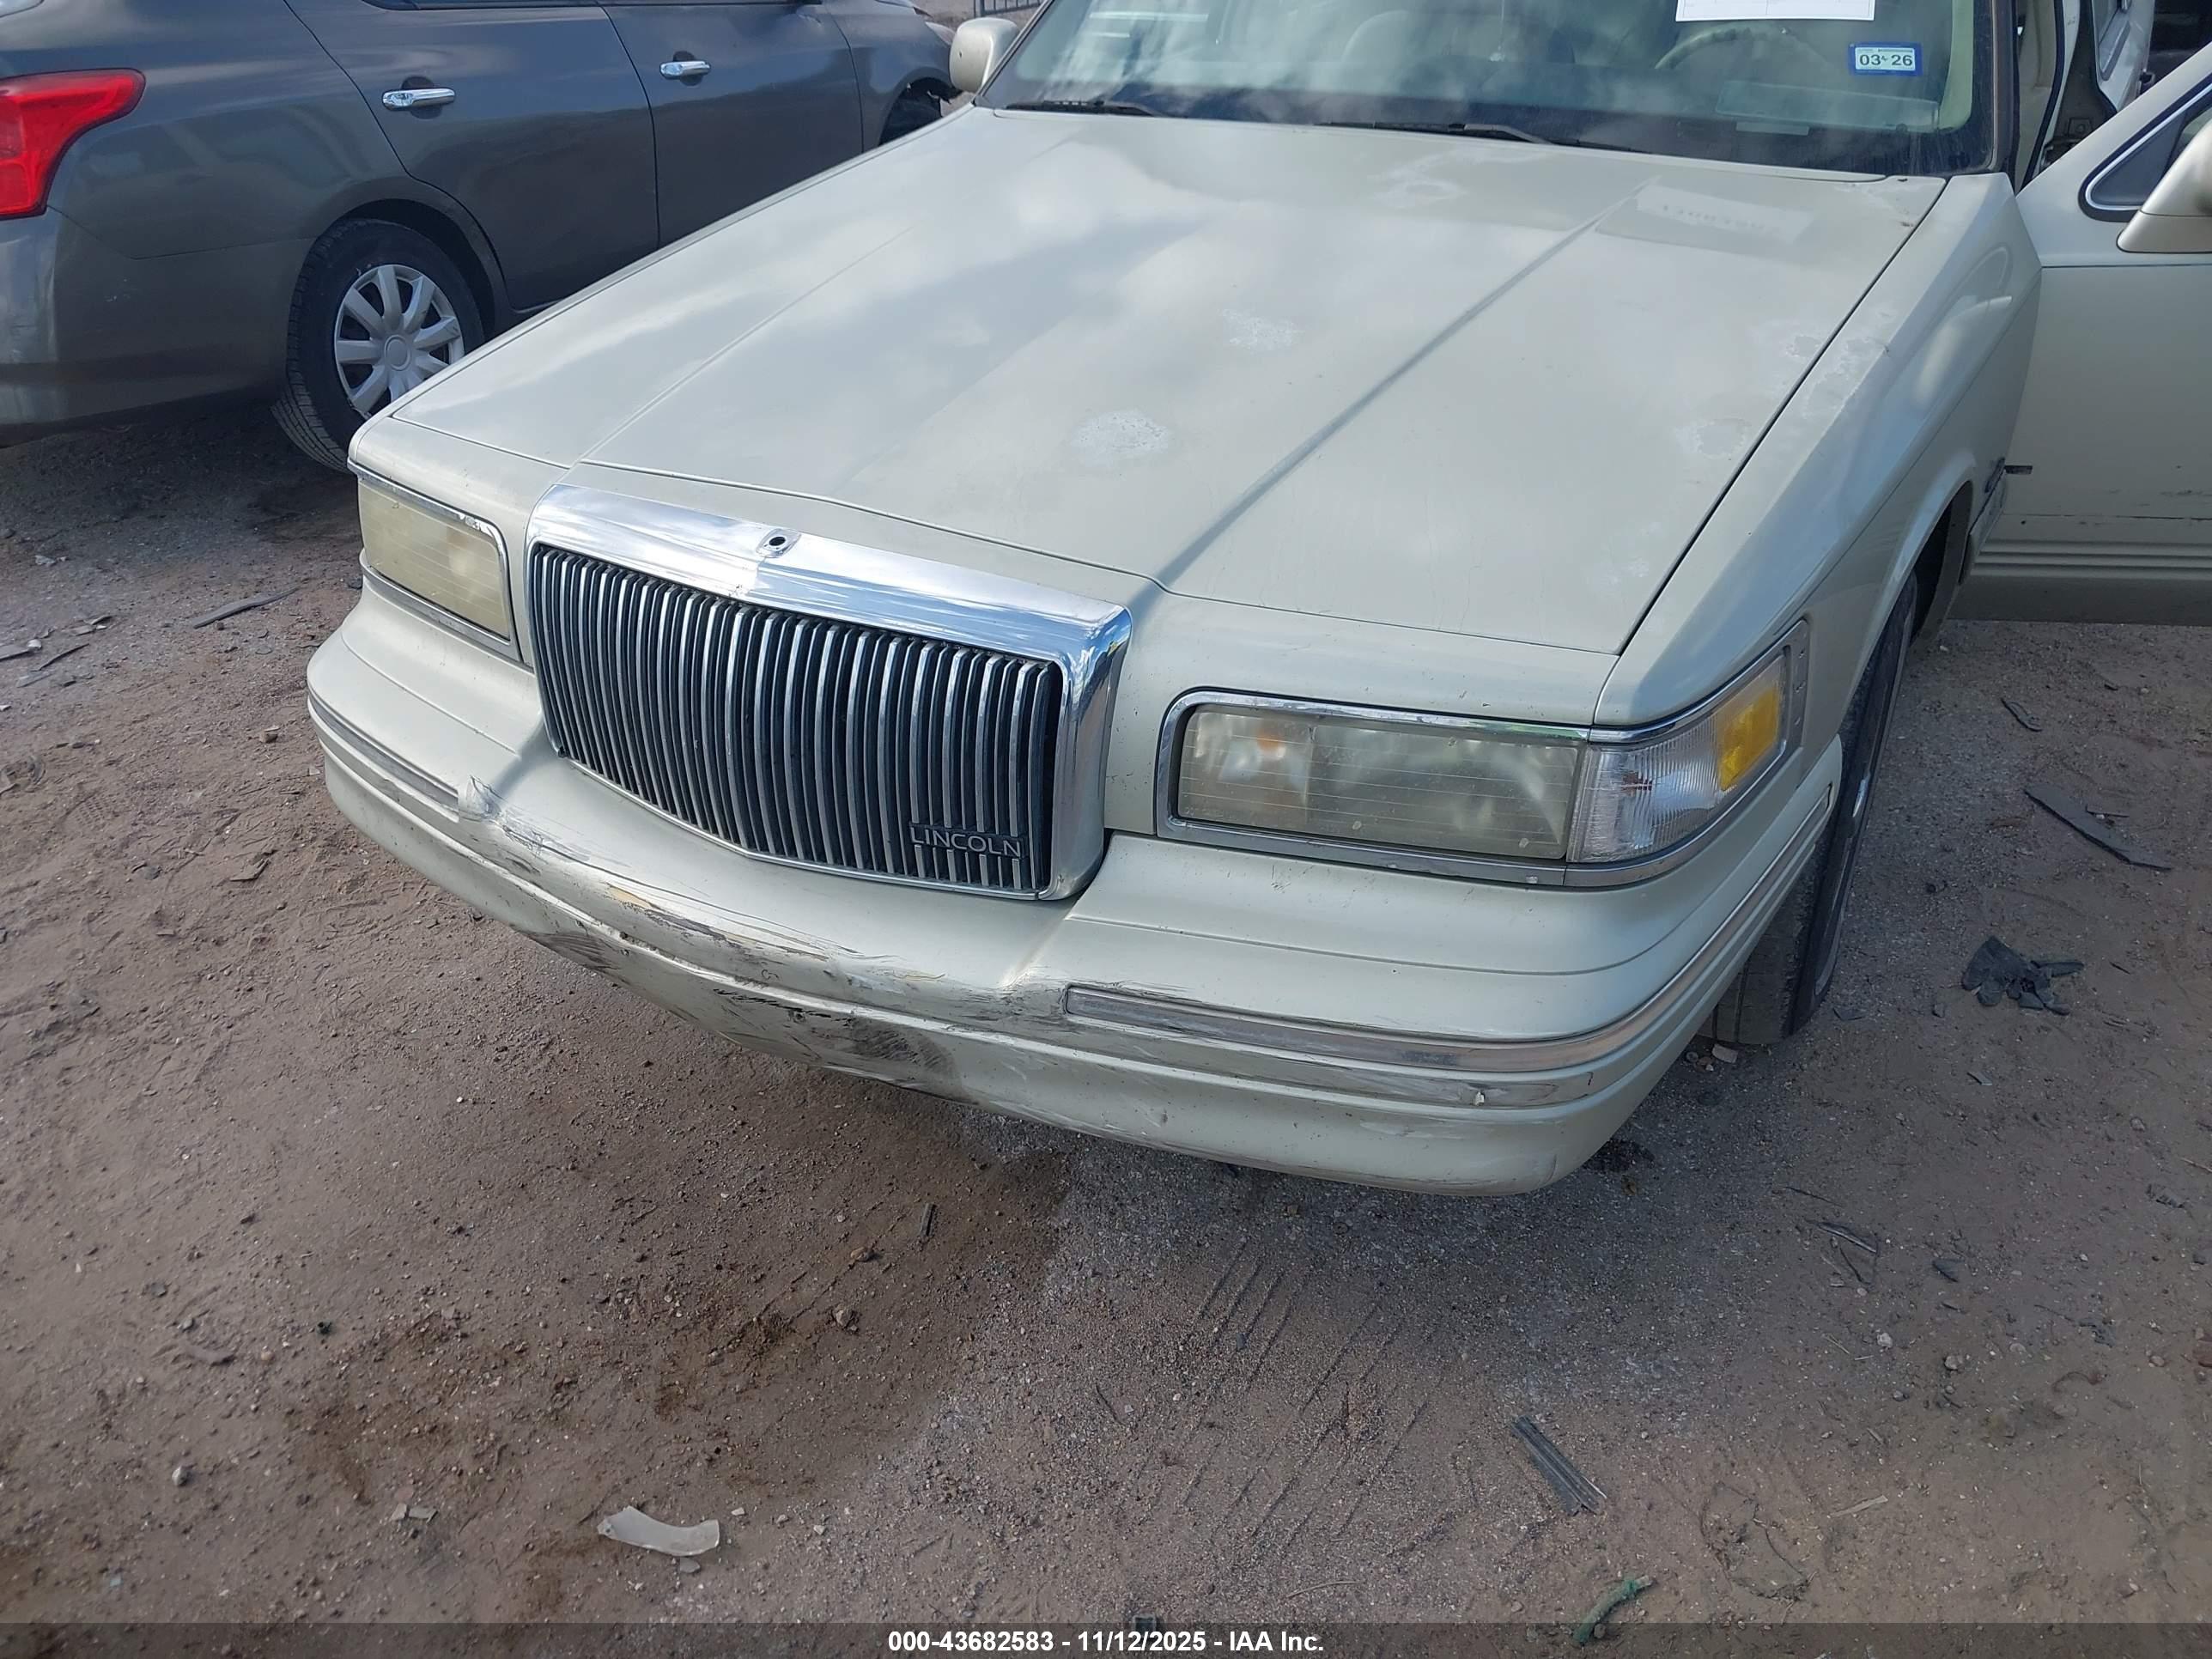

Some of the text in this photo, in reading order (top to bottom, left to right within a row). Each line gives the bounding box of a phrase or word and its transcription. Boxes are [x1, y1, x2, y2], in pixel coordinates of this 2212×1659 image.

[1859, 54, 1913, 66] 03 26
[910, 826, 1021, 858] LINCOLN
